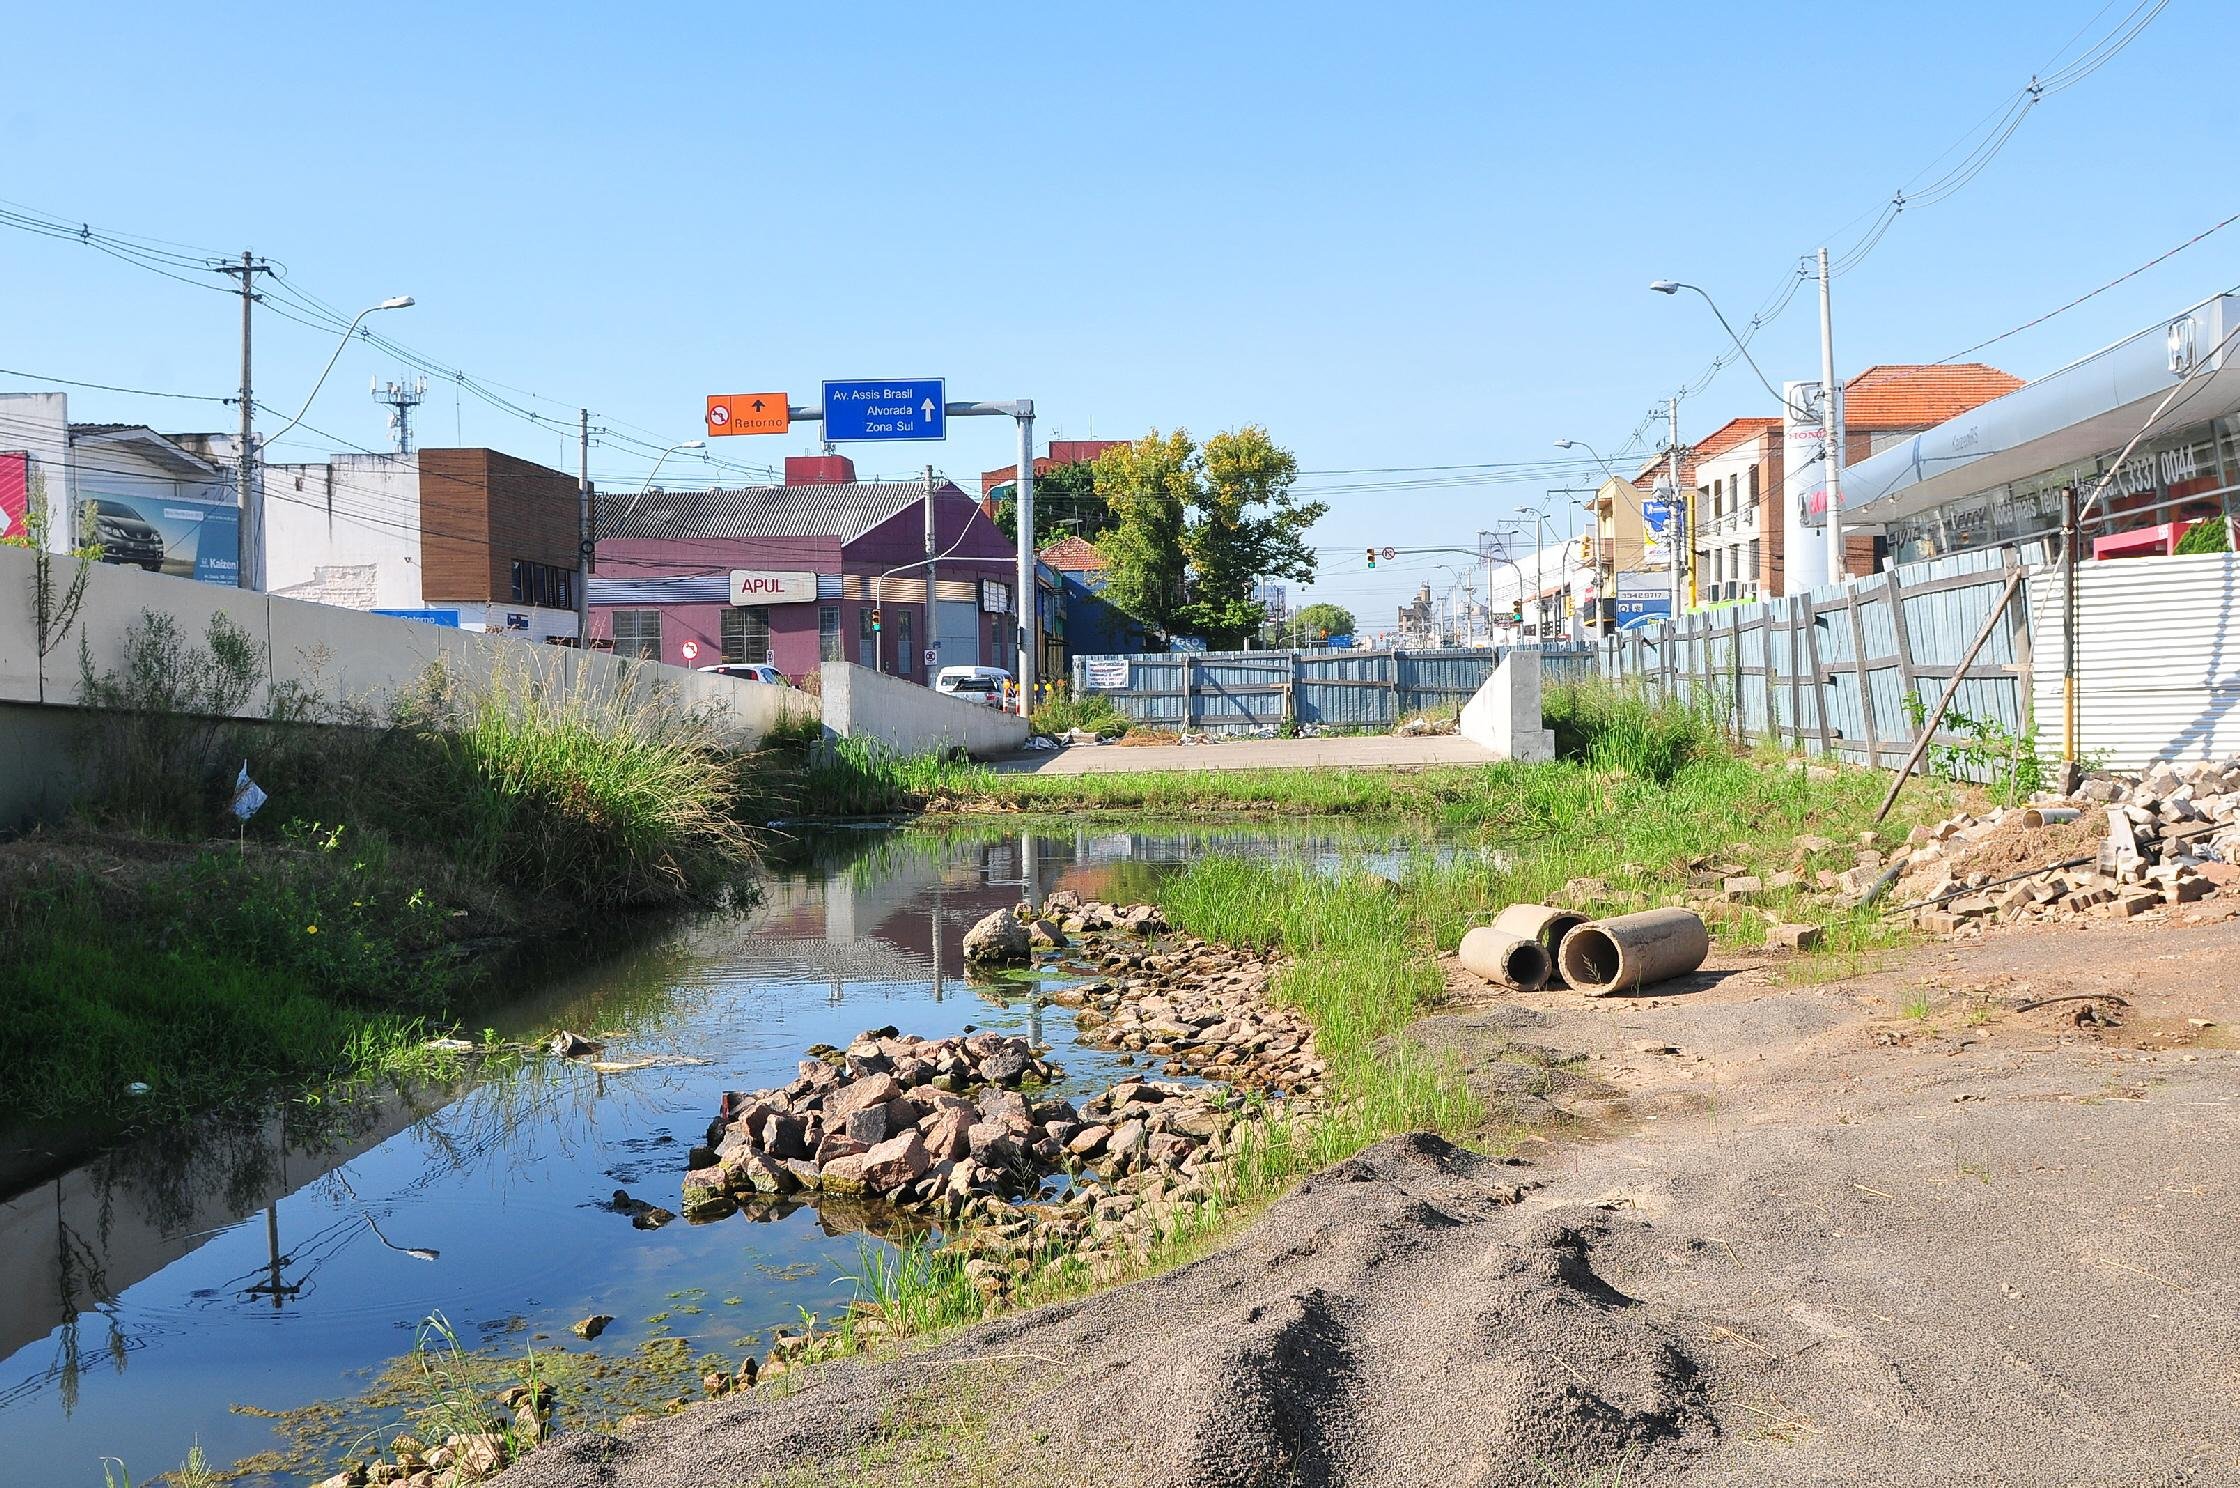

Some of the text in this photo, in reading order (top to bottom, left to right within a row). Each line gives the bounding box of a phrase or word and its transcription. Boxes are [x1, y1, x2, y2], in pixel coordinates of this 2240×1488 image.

[833, 388, 913, 401] Av. Assis Brasil
[867, 406, 913, 416] Alvorada
[735, 418, 783, 430] Retorno
[866, 421, 914, 433] Zona Sul
[2126, 458, 2157, 493] 3337
[2160, 443, 2197, 486] 0044
[2015, 492, 2037, 520] mais
[741, 579, 785, 593] APUL
